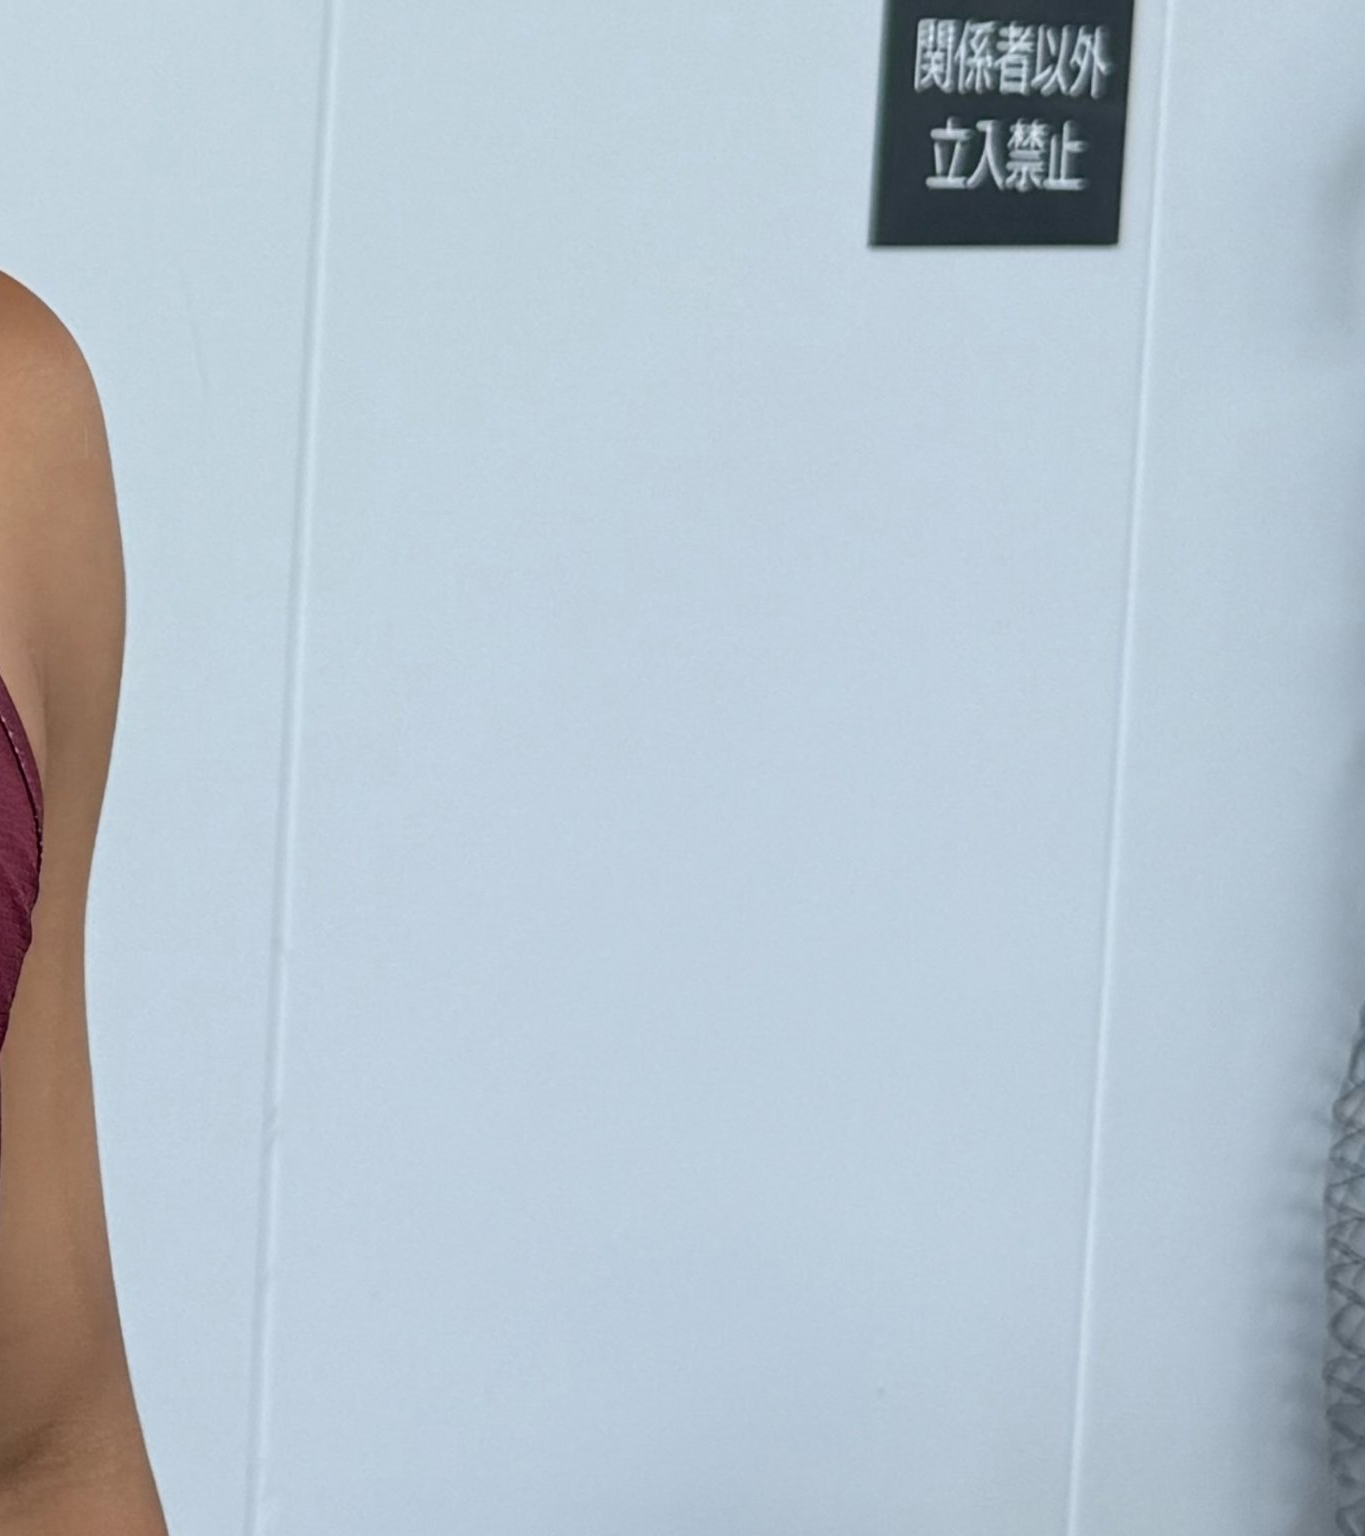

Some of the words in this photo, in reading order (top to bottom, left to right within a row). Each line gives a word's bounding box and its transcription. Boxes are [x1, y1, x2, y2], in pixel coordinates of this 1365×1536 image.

[913, 17, 1116, 99] 関係者以外
[924, 115, 1091, 193] 立入禁止
